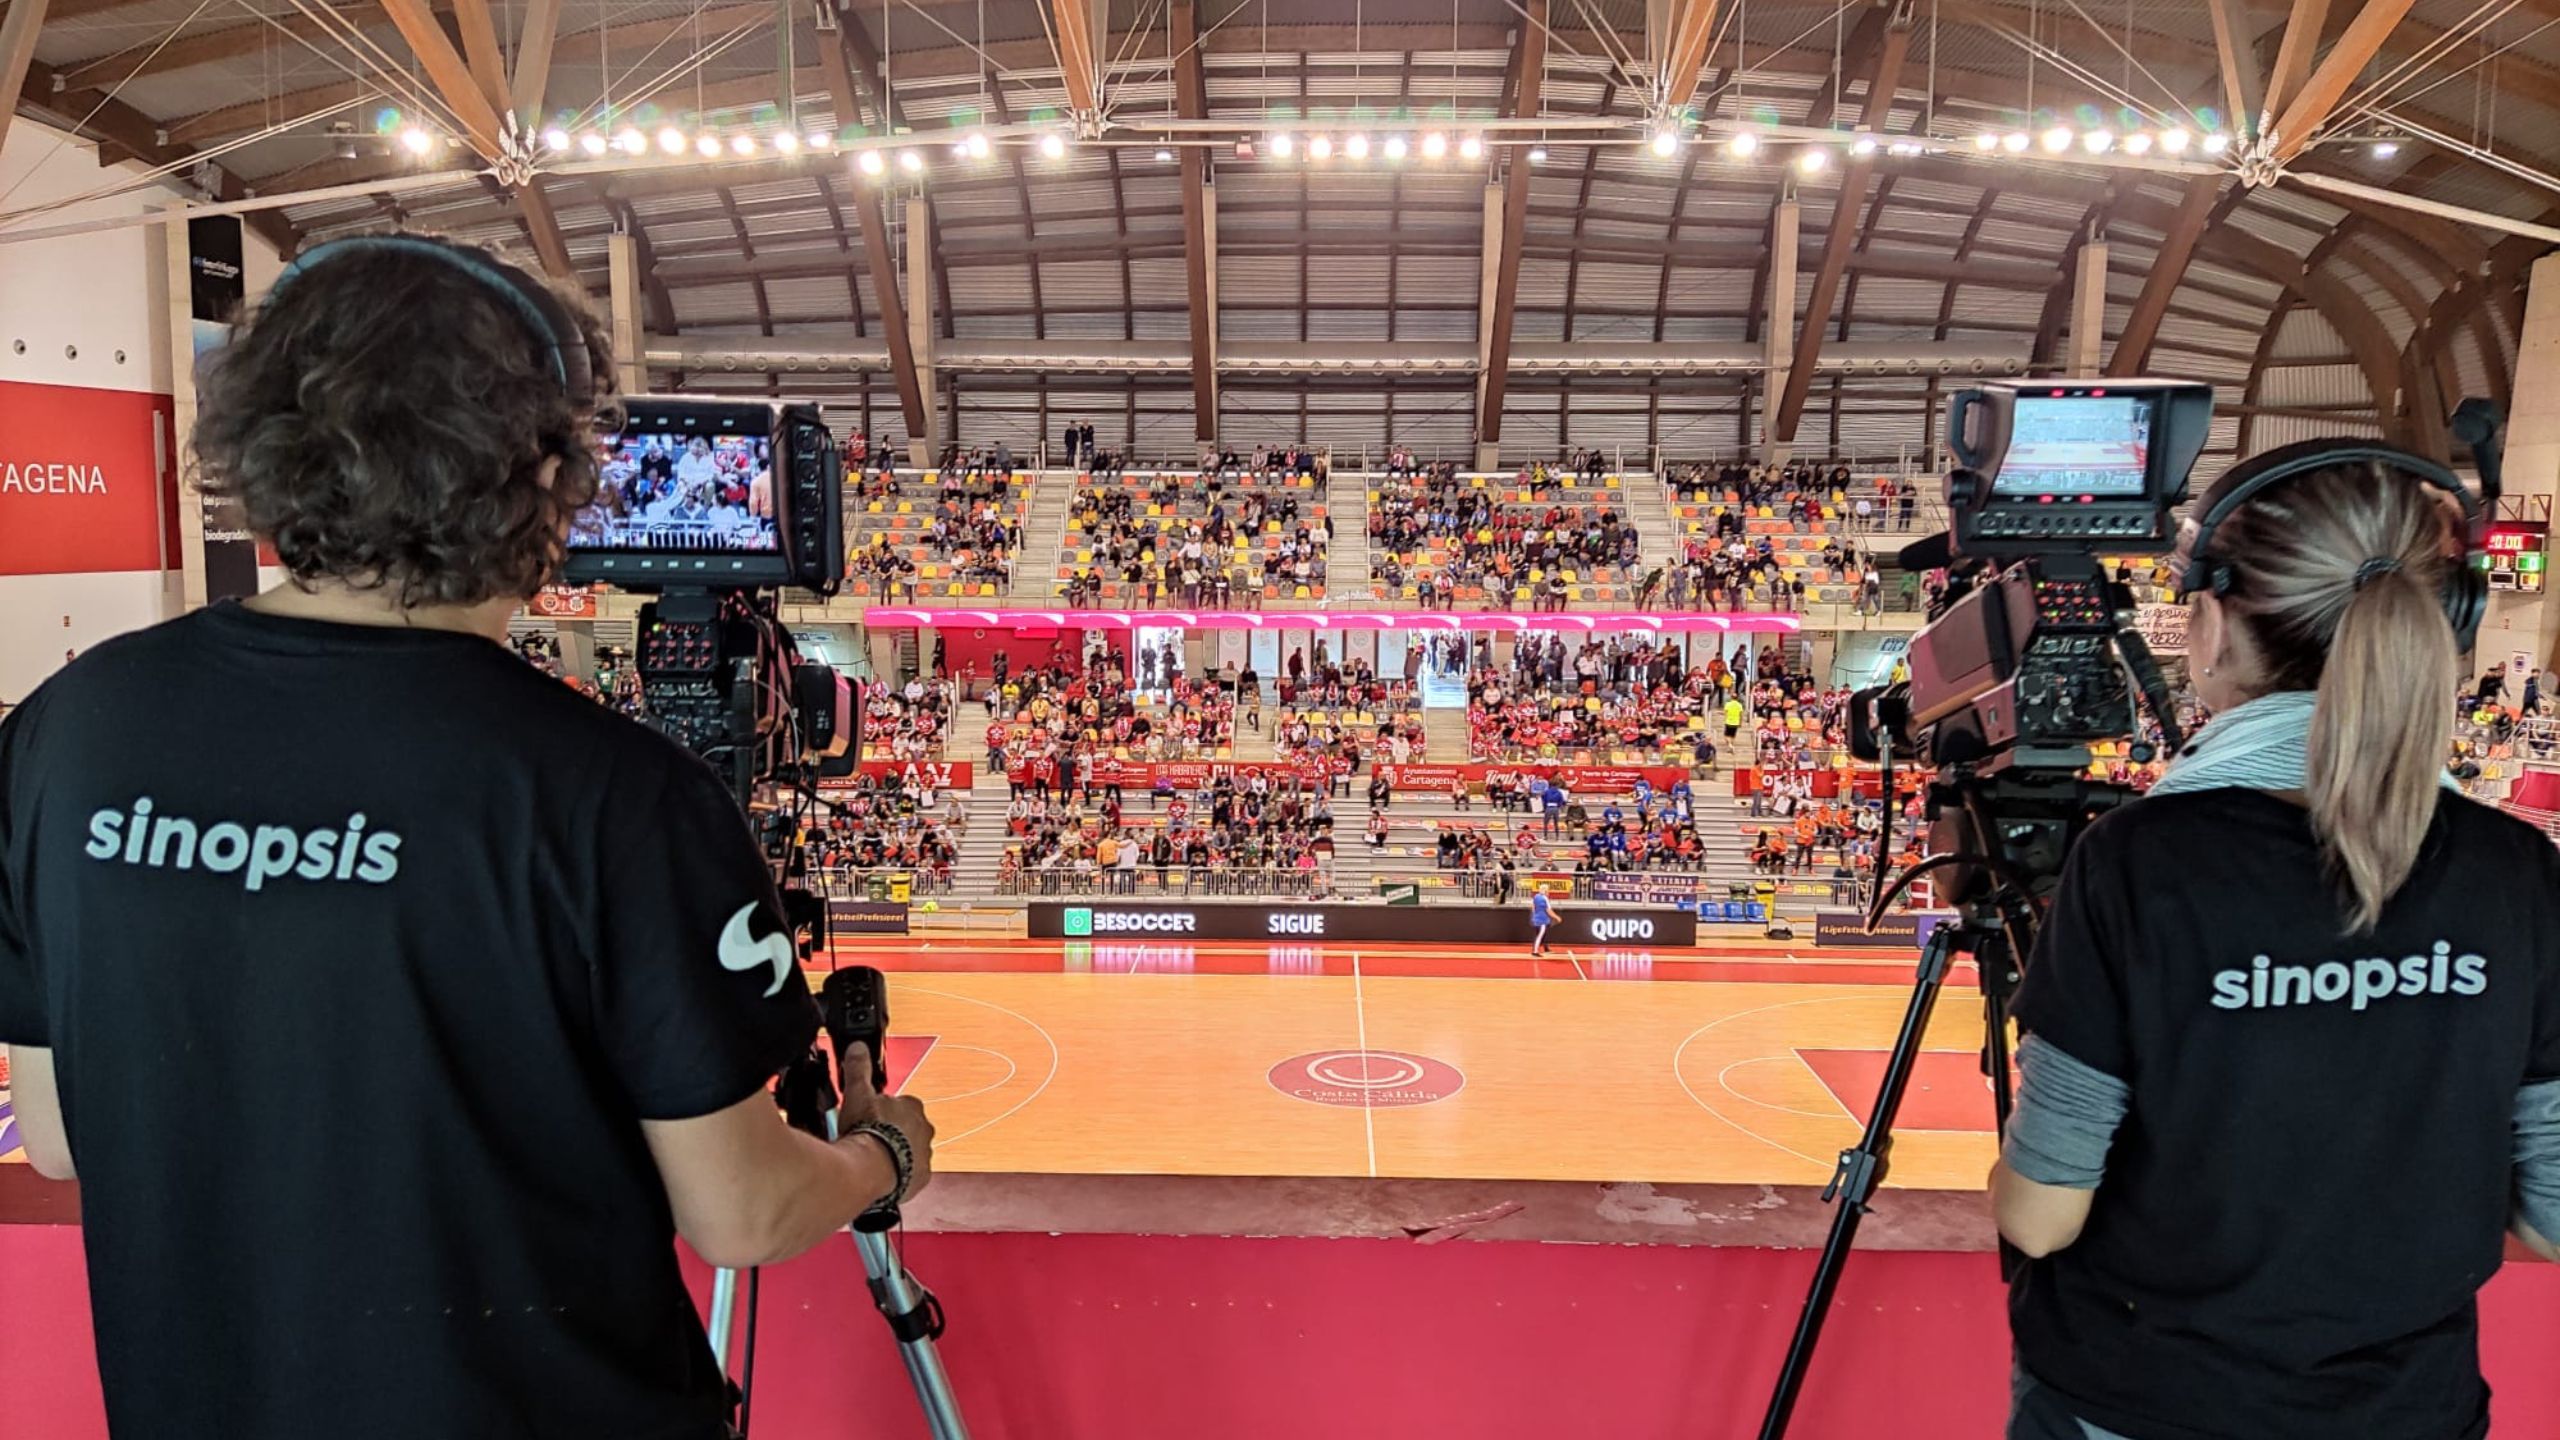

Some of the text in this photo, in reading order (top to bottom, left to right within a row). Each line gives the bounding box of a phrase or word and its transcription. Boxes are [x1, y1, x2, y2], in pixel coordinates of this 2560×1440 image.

[0, 462, 107, 494] AGENA
[85, 796, 402, 891] sinopsis
[1093, 912, 1654, 940] BESOCCER SIGUE QUIPO
[2210, 940, 2488, 1011] sinopsis
[1294, 1088, 1358, 1098] Costa
